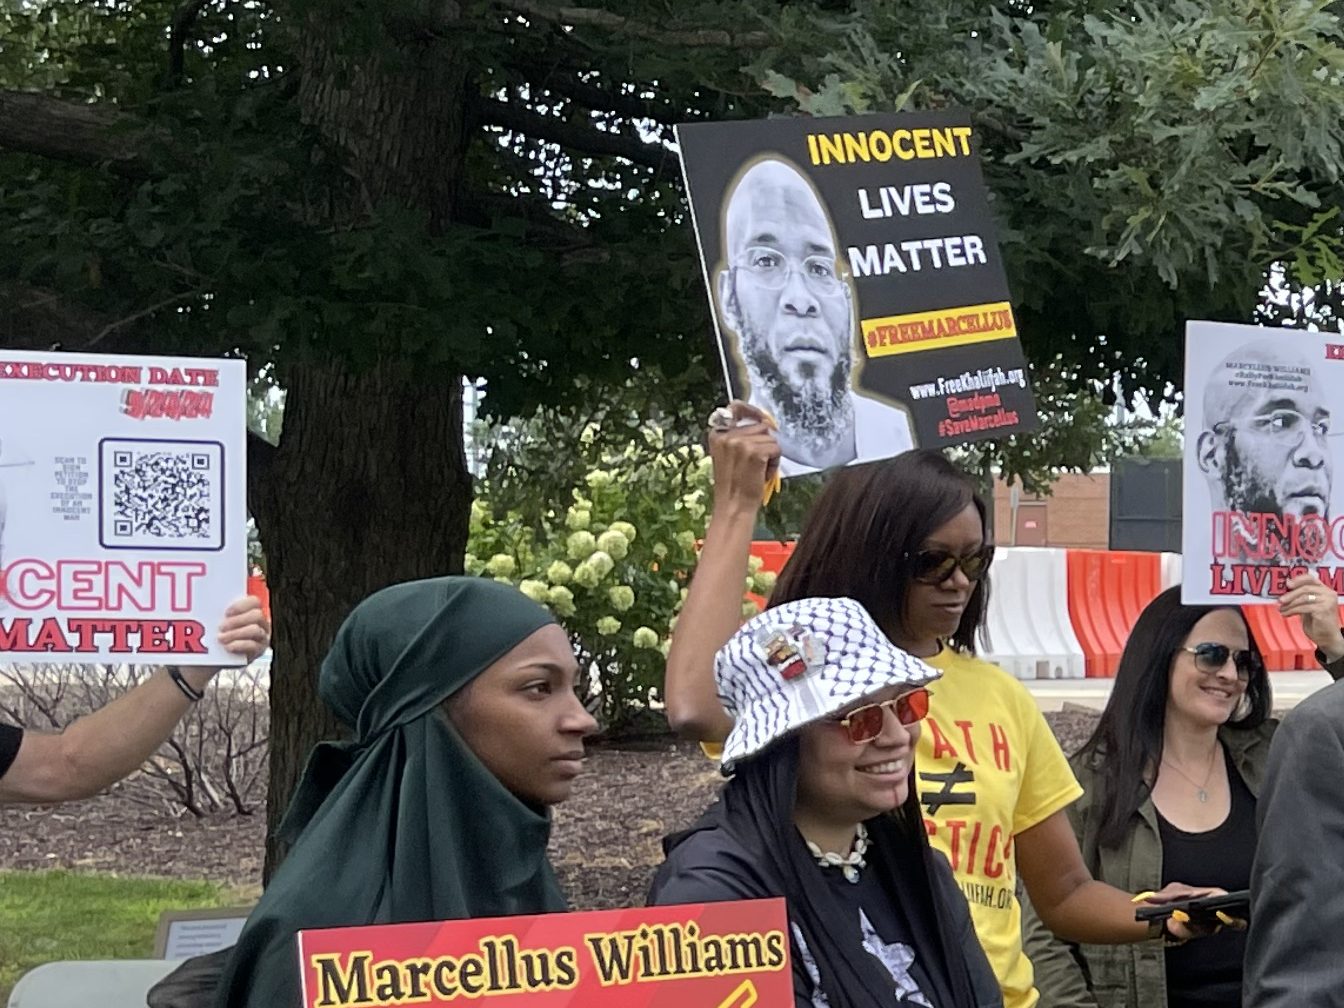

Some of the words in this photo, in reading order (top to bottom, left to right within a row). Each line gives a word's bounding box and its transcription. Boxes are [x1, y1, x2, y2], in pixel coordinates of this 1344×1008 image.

[807, 127, 972, 166] INNOCENT
[858, 182, 955, 220] LIVES
[848, 235, 987, 278] MATTER
[148, 366, 219, 387] DATE
[4, 558, 206, 612] CENT
[0, 617, 208, 654] MATTER
[314, 937, 577, 1008] Marcellus
[587, 921, 785, 984] Williams
